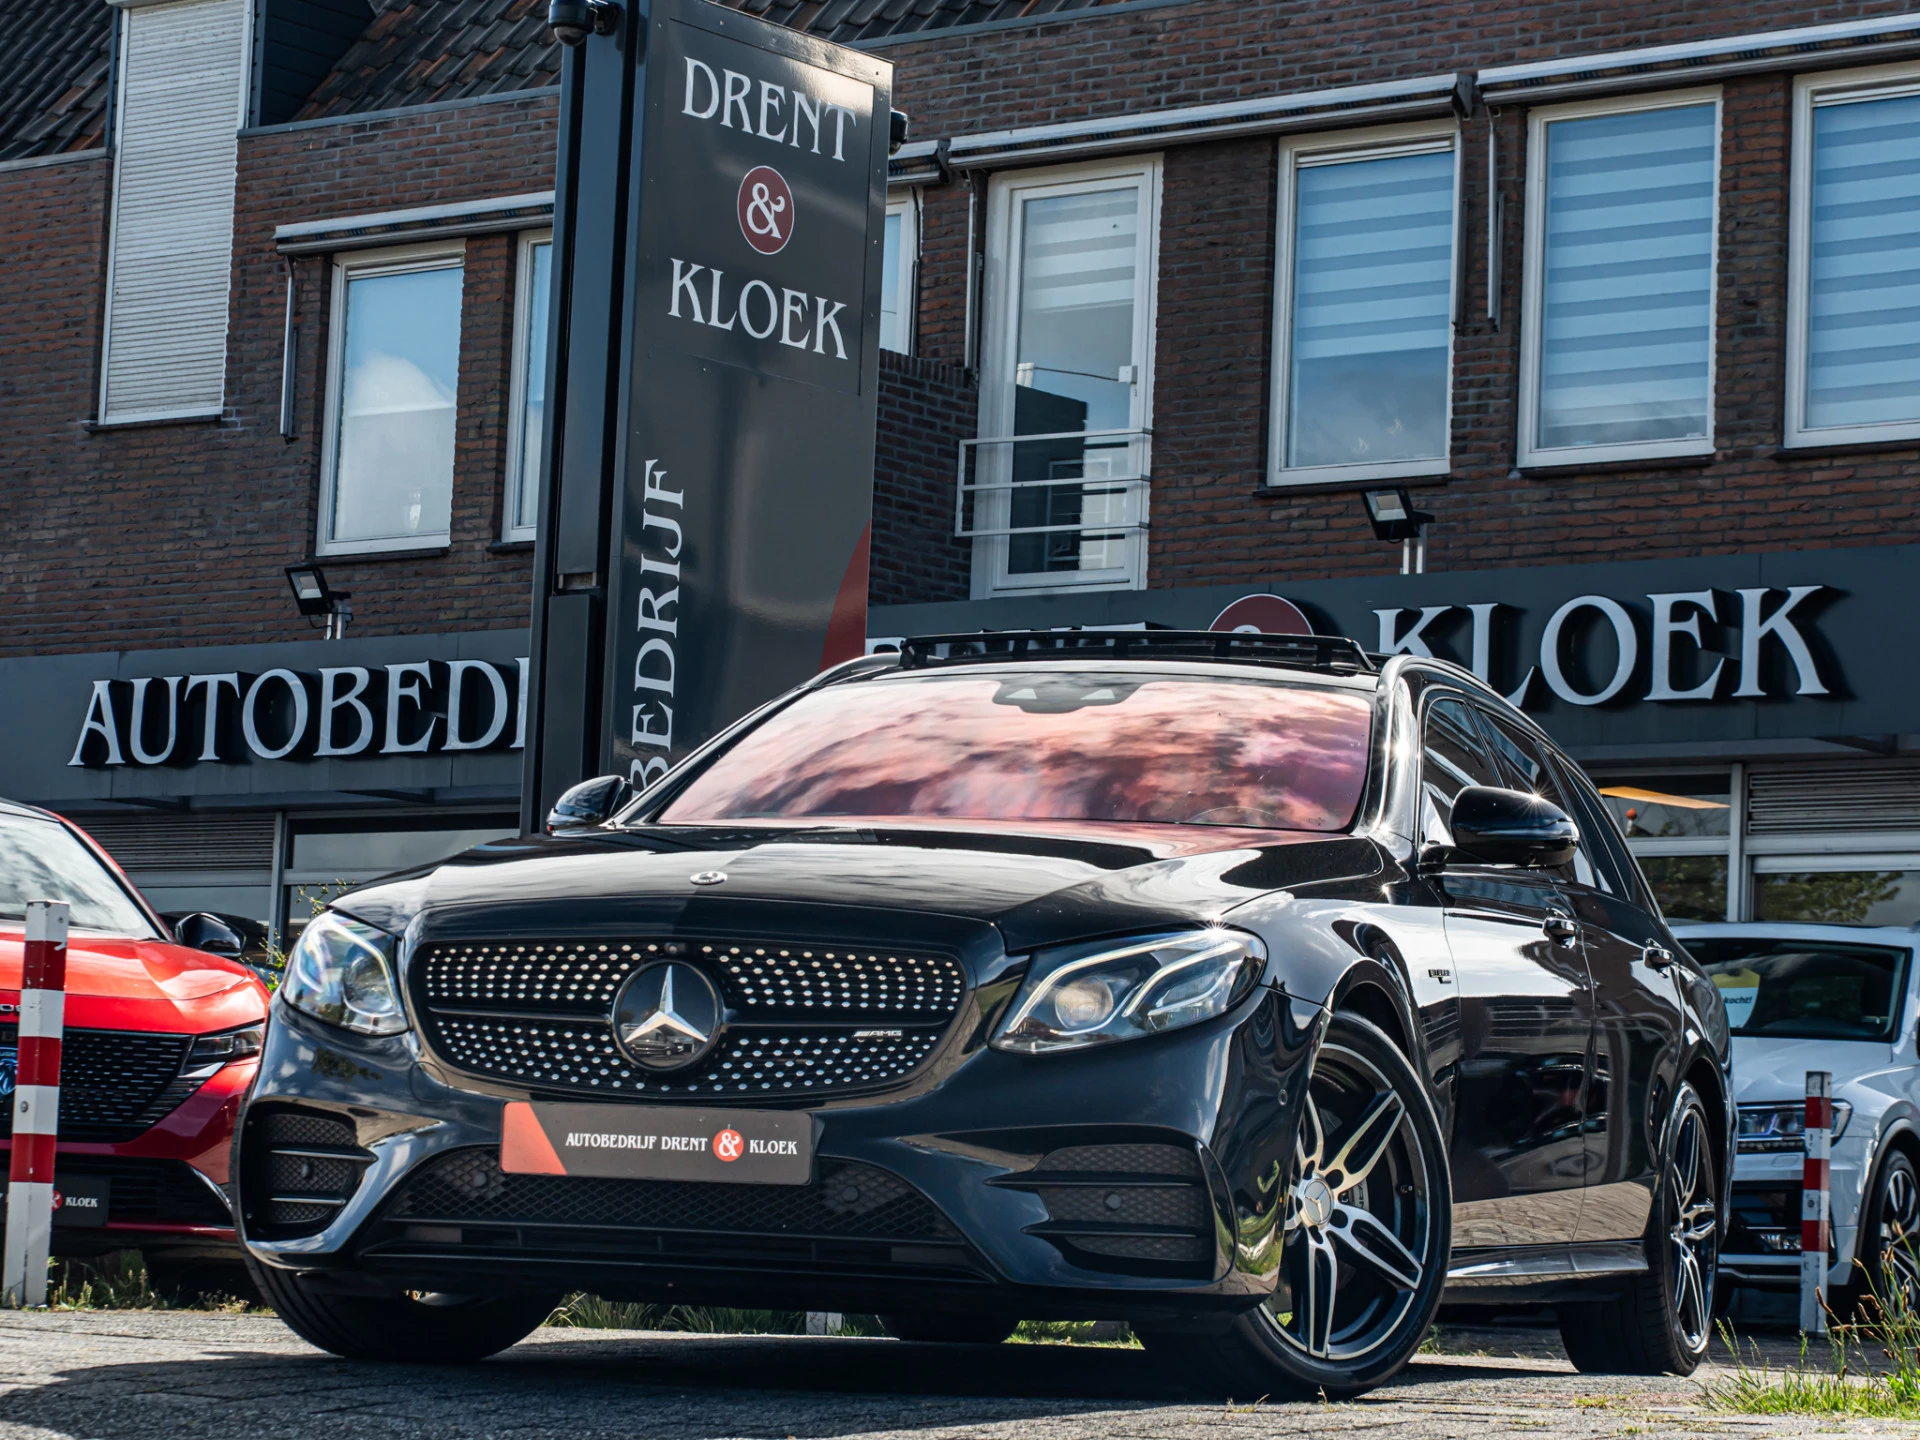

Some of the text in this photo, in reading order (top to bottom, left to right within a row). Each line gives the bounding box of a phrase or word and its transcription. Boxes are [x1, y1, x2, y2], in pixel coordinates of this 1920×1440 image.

[681, 56, 857, 162] DRENT
[746, 182, 786, 240] &
[667, 257, 849, 360] KLOEK
[66, 656, 531, 767] AUTOBED
[565, 1131, 798, 1158] AUTOBEDRIJF DRENT & KLOEK
[65, 1197, 98, 1208] KLOEK
